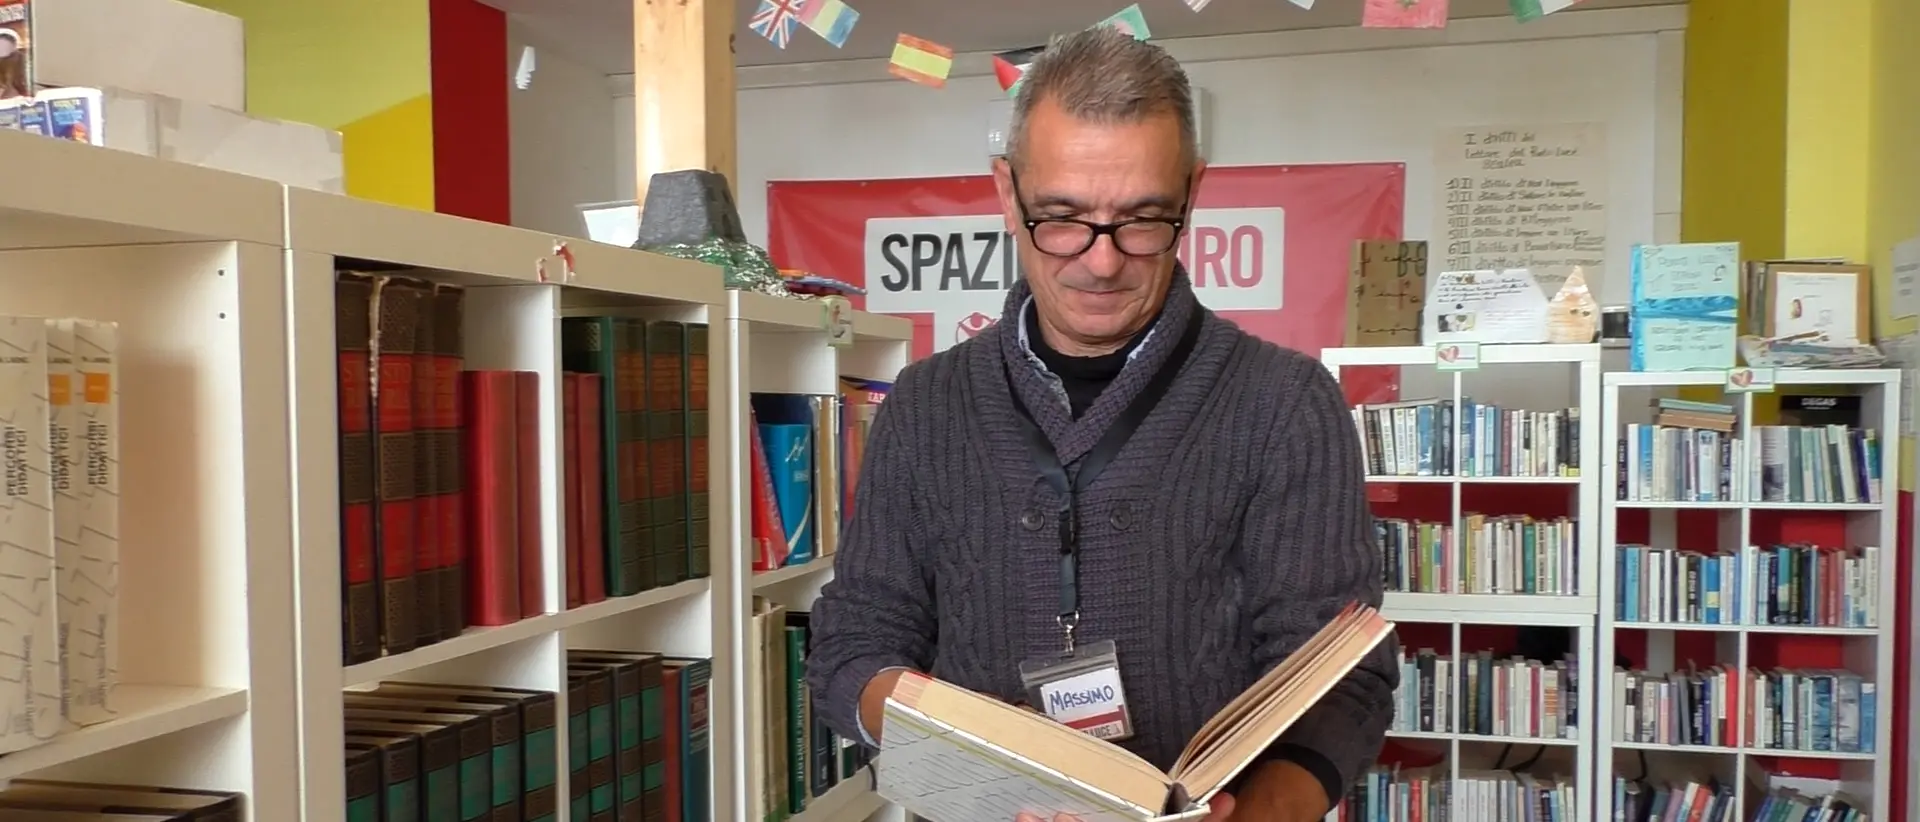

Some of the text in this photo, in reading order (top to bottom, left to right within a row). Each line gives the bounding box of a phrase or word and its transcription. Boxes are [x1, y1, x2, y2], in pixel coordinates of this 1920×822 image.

[881, 231, 1023, 292] SPAZI
[1801, 397, 1837, 406] DEGAS
[4, 426, 16, 496] PERCORSI
[17, 429, 28, 496] DIDATTICI
[58, 427, 69, 490] DIDATTICI
[98, 424, 108, 485] DIDATTICI
[1049, 685, 1114, 715] MASSIMO
